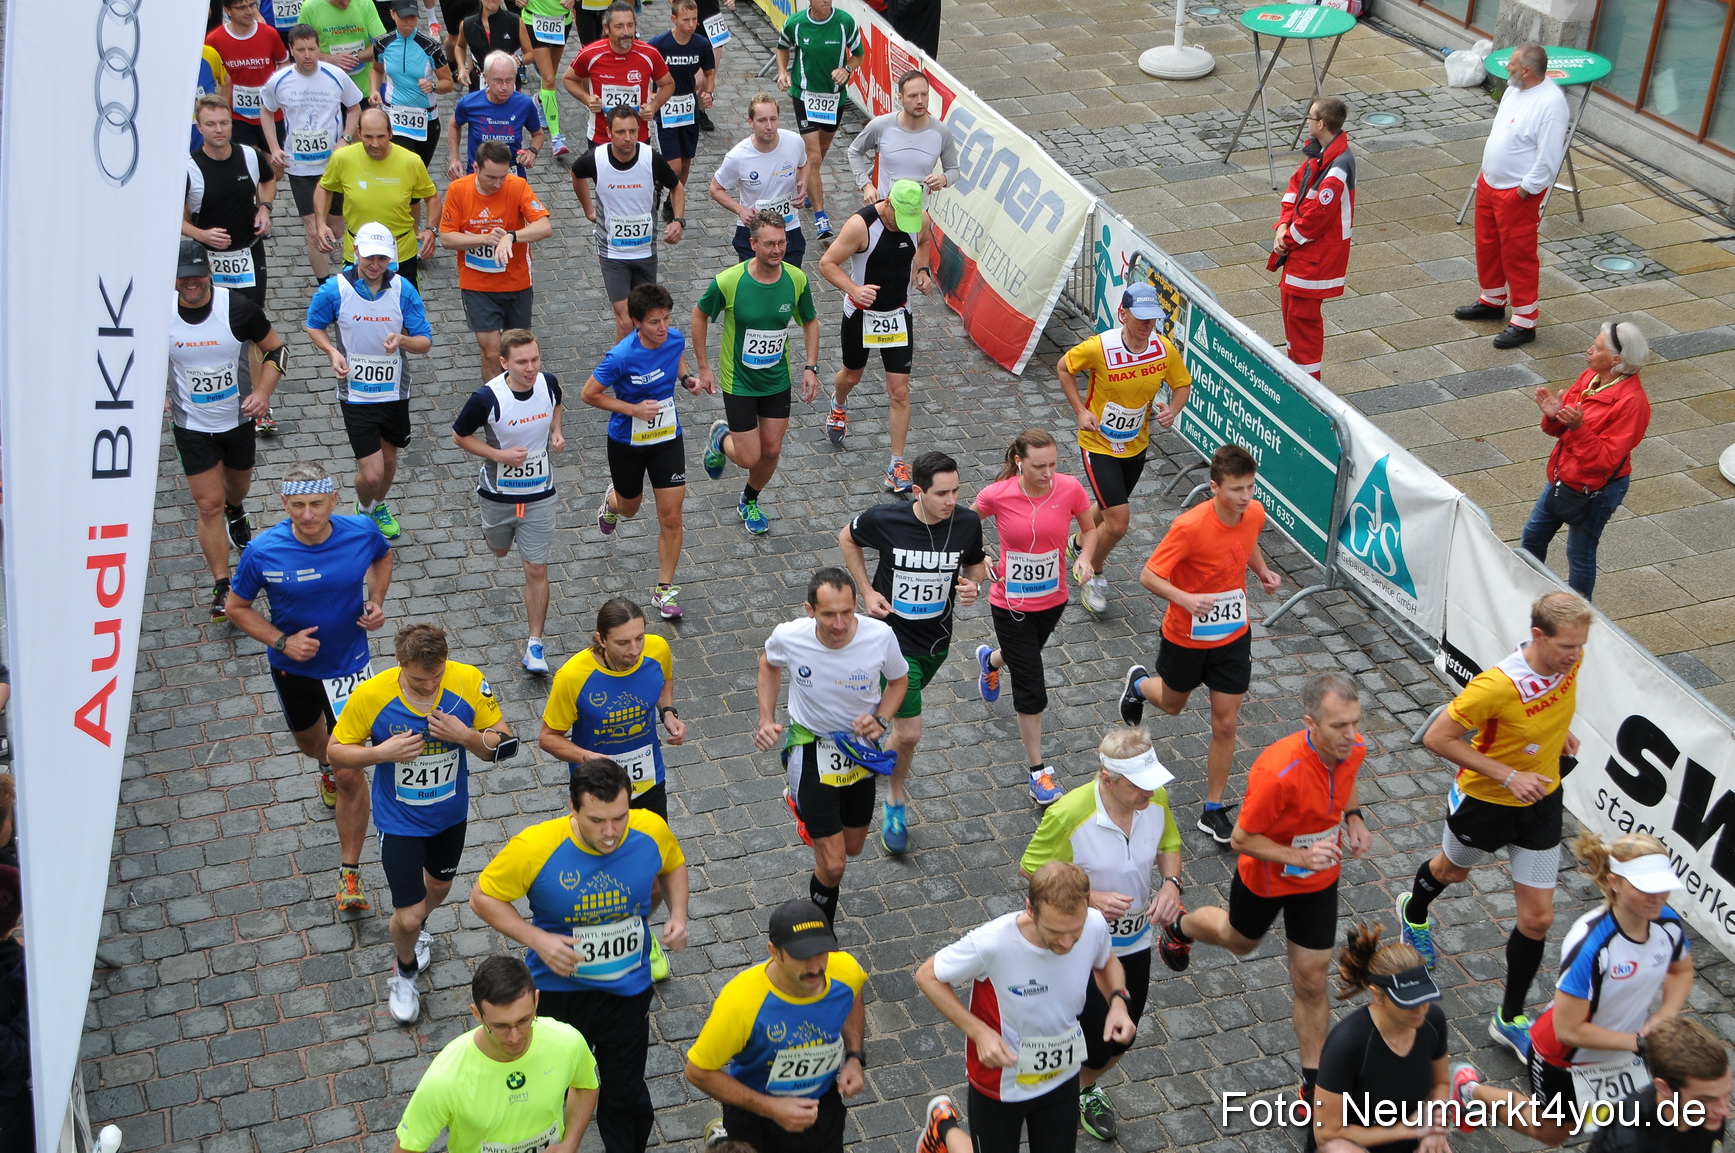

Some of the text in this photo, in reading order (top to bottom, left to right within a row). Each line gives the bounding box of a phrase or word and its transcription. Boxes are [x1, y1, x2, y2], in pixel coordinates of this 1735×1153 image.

[536, 20, 562, 33] 2605
[225, 58, 264, 68] NEUMARKT
[665, 56, 700, 65] ADIDAS
[606, 93, 638, 106] 2524
[808, 98, 835, 112] 2392
[664, 102, 692, 114] 2415
[393, 114, 424, 128] 3349
[295, 137, 328, 152] 2345
[615, 224, 650, 238] 2537
[214, 258, 250, 273] 2862
[873, 318, 899, 333] 294
[748, 338, 782, 354] 2353
[753, 356, 774, 364] Thomas
[354, 365, 394, 382] 2060
[1108, 362, 1168, 382] MAX BÖGL
[1212, 336, 1281, 404] Event-Leit-Systeme
[192, 372, 234, 392] 2378
[364, 384, 382, 393] Georg
[206, 392, 225, 402] Peter
[1190, 358, 1282, 454] Mehr Sicherheit
[519, 412, 549, 424] KLEBL
[1106, 412, 1143, 430] 2047
[642, 430, 668, 441] Marianne
[1186, 420, 1202, 443] Miet
[1202, 436, 1208, 449] &
[1206, 404, 1224, 429] Ihr
[1226, 421, 1264, 467] Event!
[503, 462, 544, 478] 2551
[504, 478, 544, 488] Christopher
[74, 274, 134, 748] Audi BKK
[1253, 484, 1295, 530] 09181 6352
[892, 548, 960, 570] THULE
[896, 574, 914, 582] PARTL
[1012, 562, 1055, 581] 2897
[1342, 552, 1417, 615] Gebäude Service GmbH
[898, 582, 944, 602] 2151
[1526, 693, 1559, 718] MAX
[420, 757, 450, 766] Neumarkt
[616, 754, 644, 764] Neumarkt
[830, 752, 856, 771] 34
[402, 762, 454, 786] 2417
[418, 790, 438, 799] Rudi
[1109, 918, 1147, 936] 330
[582, 932, 638, 963] 3406
[1022, 1040, 1046, 1050] PARTL
[1034, 1044, 1074, 1070] 331
[778, 1052, 838, 1079] 2677
[790, 1080, 817, 1091] Josef
[1590, 1071, 1636, 1100] 750
